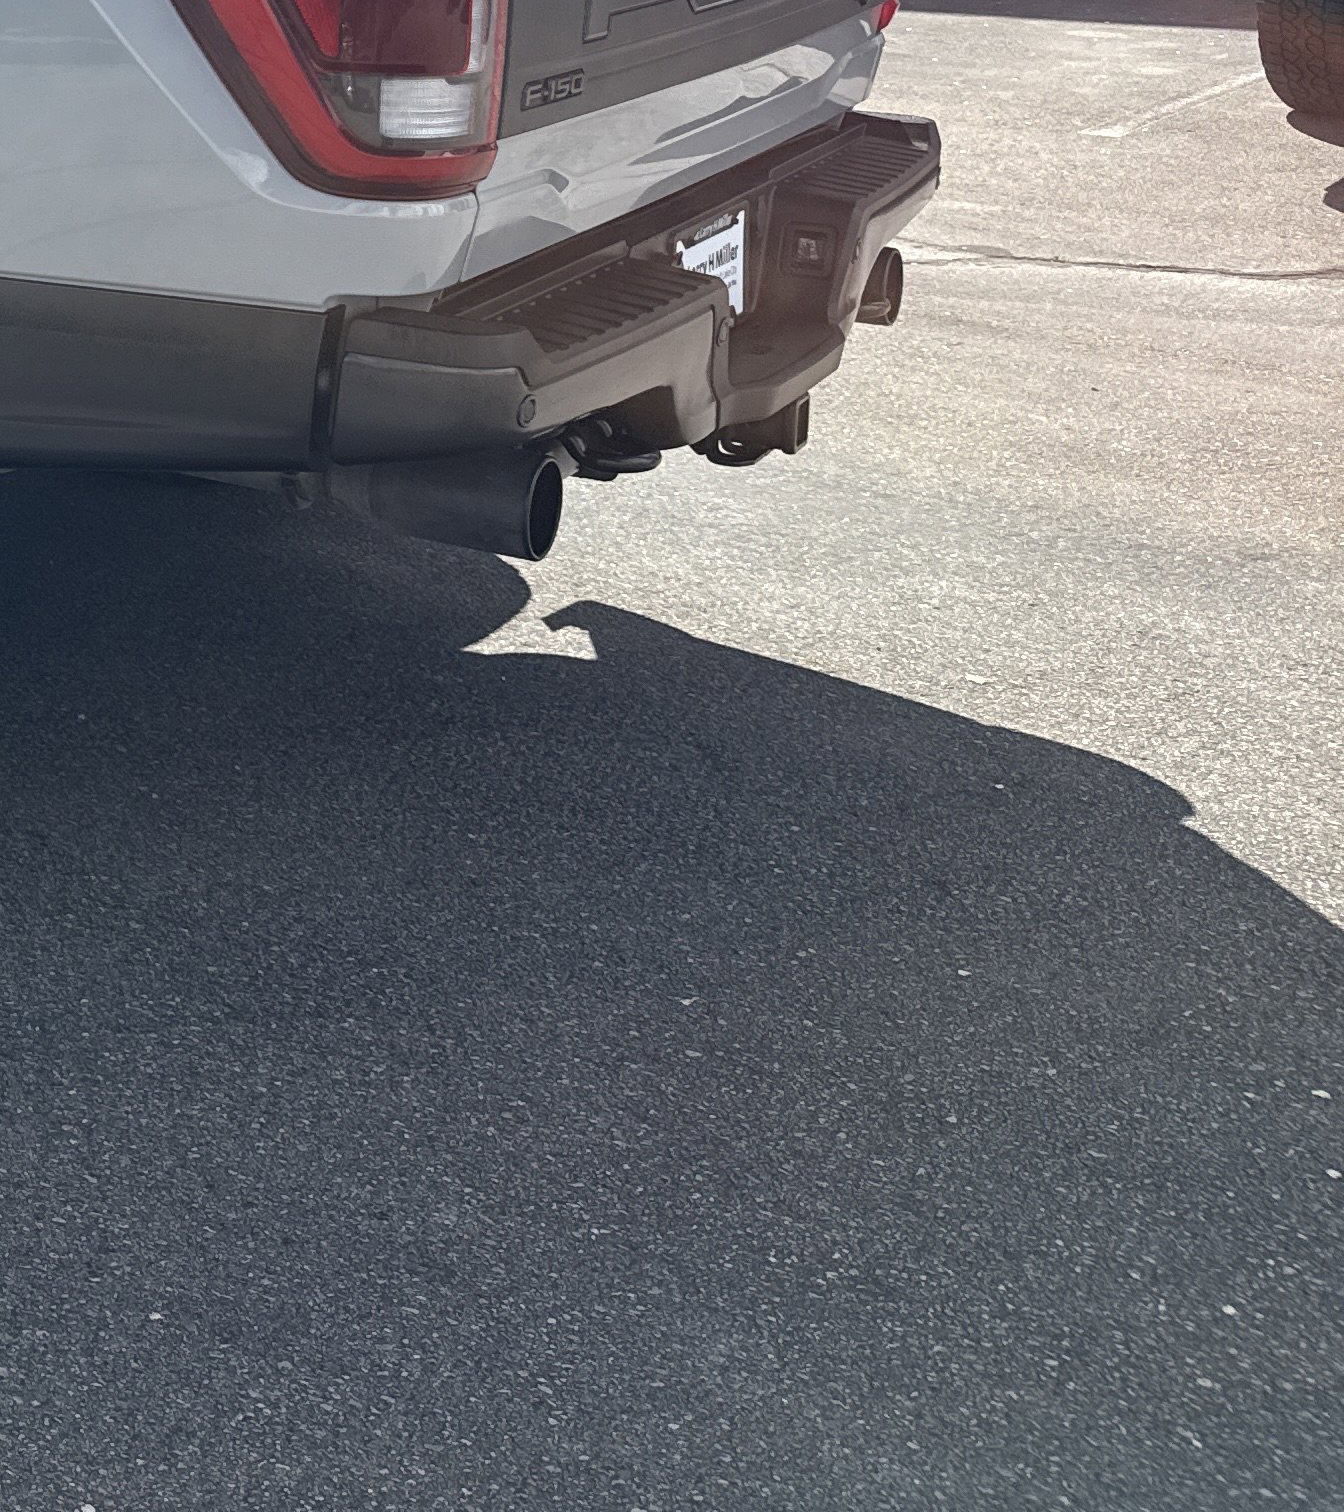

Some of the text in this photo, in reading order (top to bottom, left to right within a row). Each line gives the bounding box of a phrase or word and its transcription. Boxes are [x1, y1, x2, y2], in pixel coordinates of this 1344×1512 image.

[522, 70, 585, 109] F-150
[708, 253, 715, 272] H
[716, 243, 739, 268] Miller
